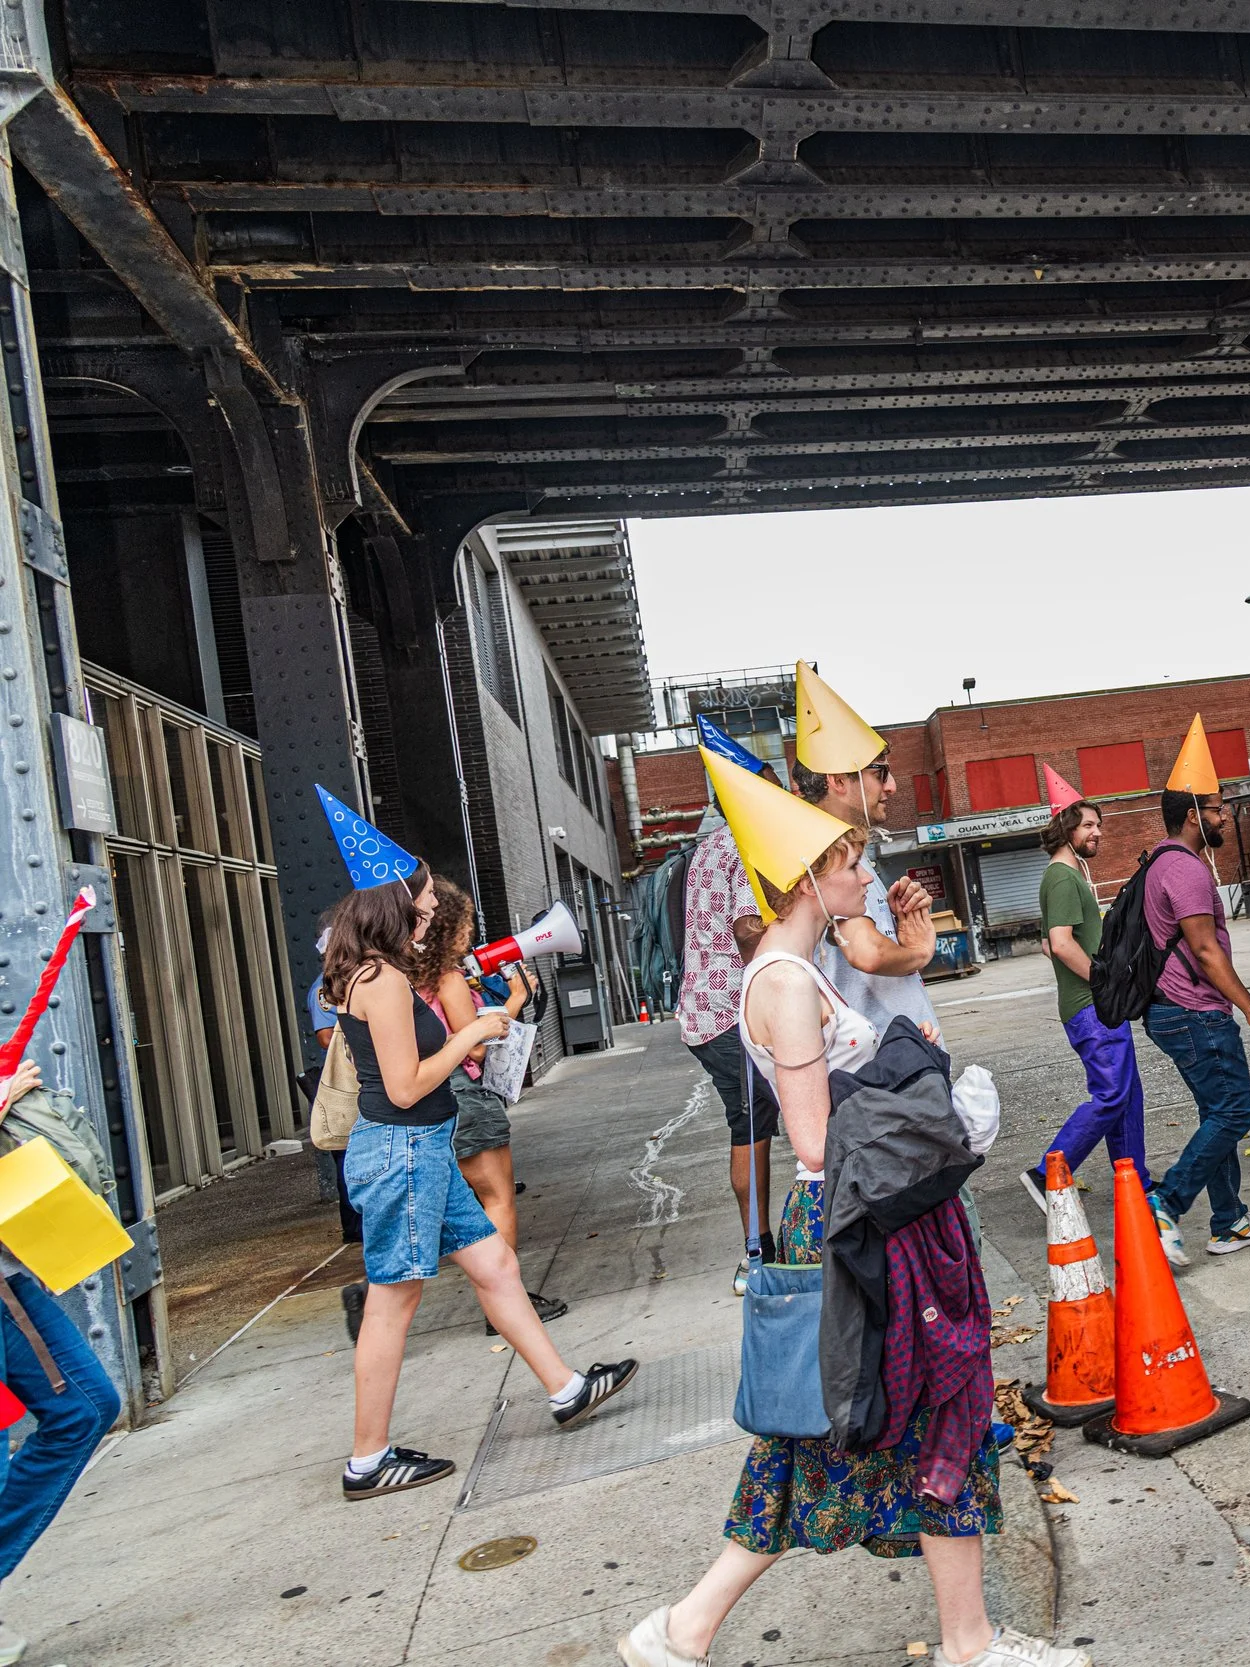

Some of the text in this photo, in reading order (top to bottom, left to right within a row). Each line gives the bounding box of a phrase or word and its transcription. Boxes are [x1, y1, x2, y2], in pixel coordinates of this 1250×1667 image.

[68, 722, 103, 769] 820
[958, 822, 997, 834] QUALITY
[999, 818, 1024, 828] VEAL
[1026, 813, 1052, 822] CORP
[535, 931, 553, 942] PYLE
